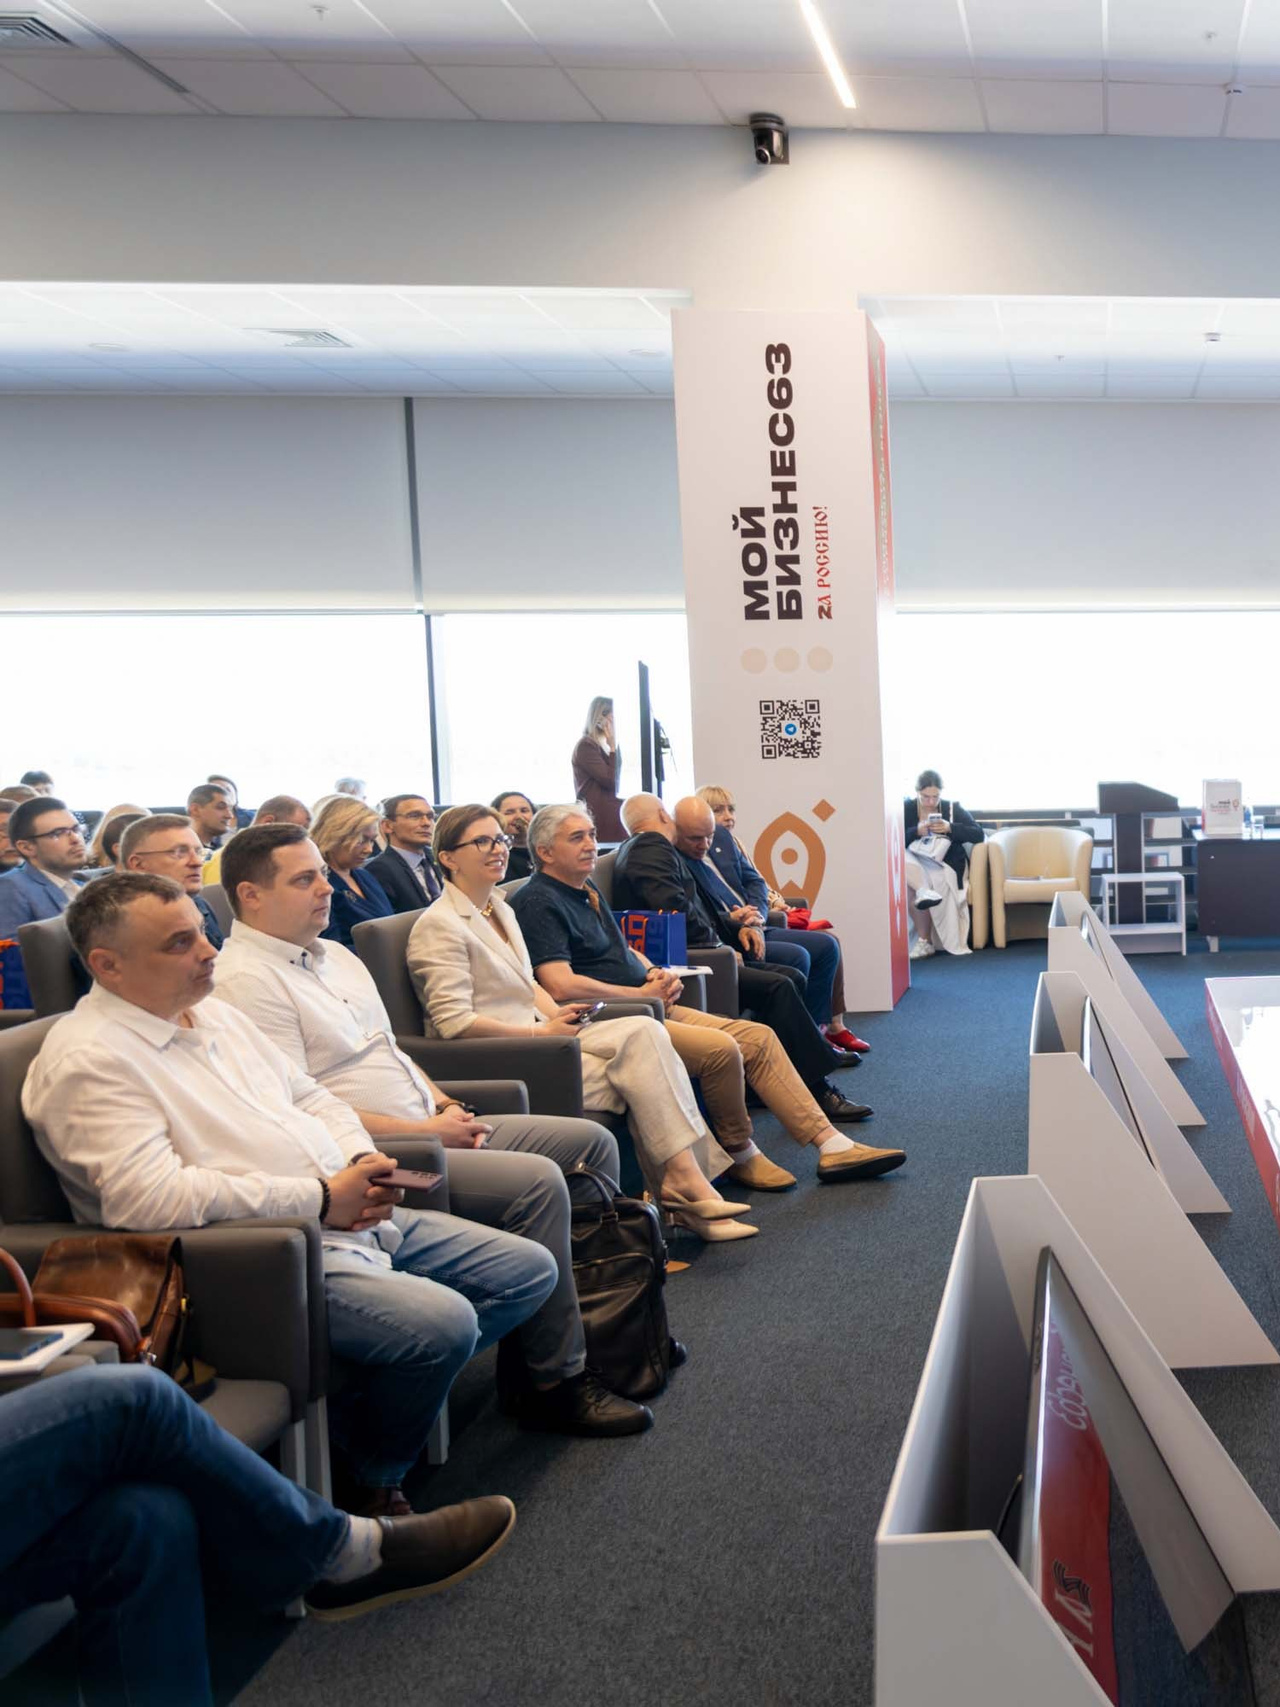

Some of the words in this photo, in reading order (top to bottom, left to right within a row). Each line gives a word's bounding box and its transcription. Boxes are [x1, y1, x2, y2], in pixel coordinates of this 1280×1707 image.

[765, 343, 803, 620] БИЗНЕС63
[731, 507, 770, 620] МОЙ
[812, 505, 831, 588] РОССИЮ!
